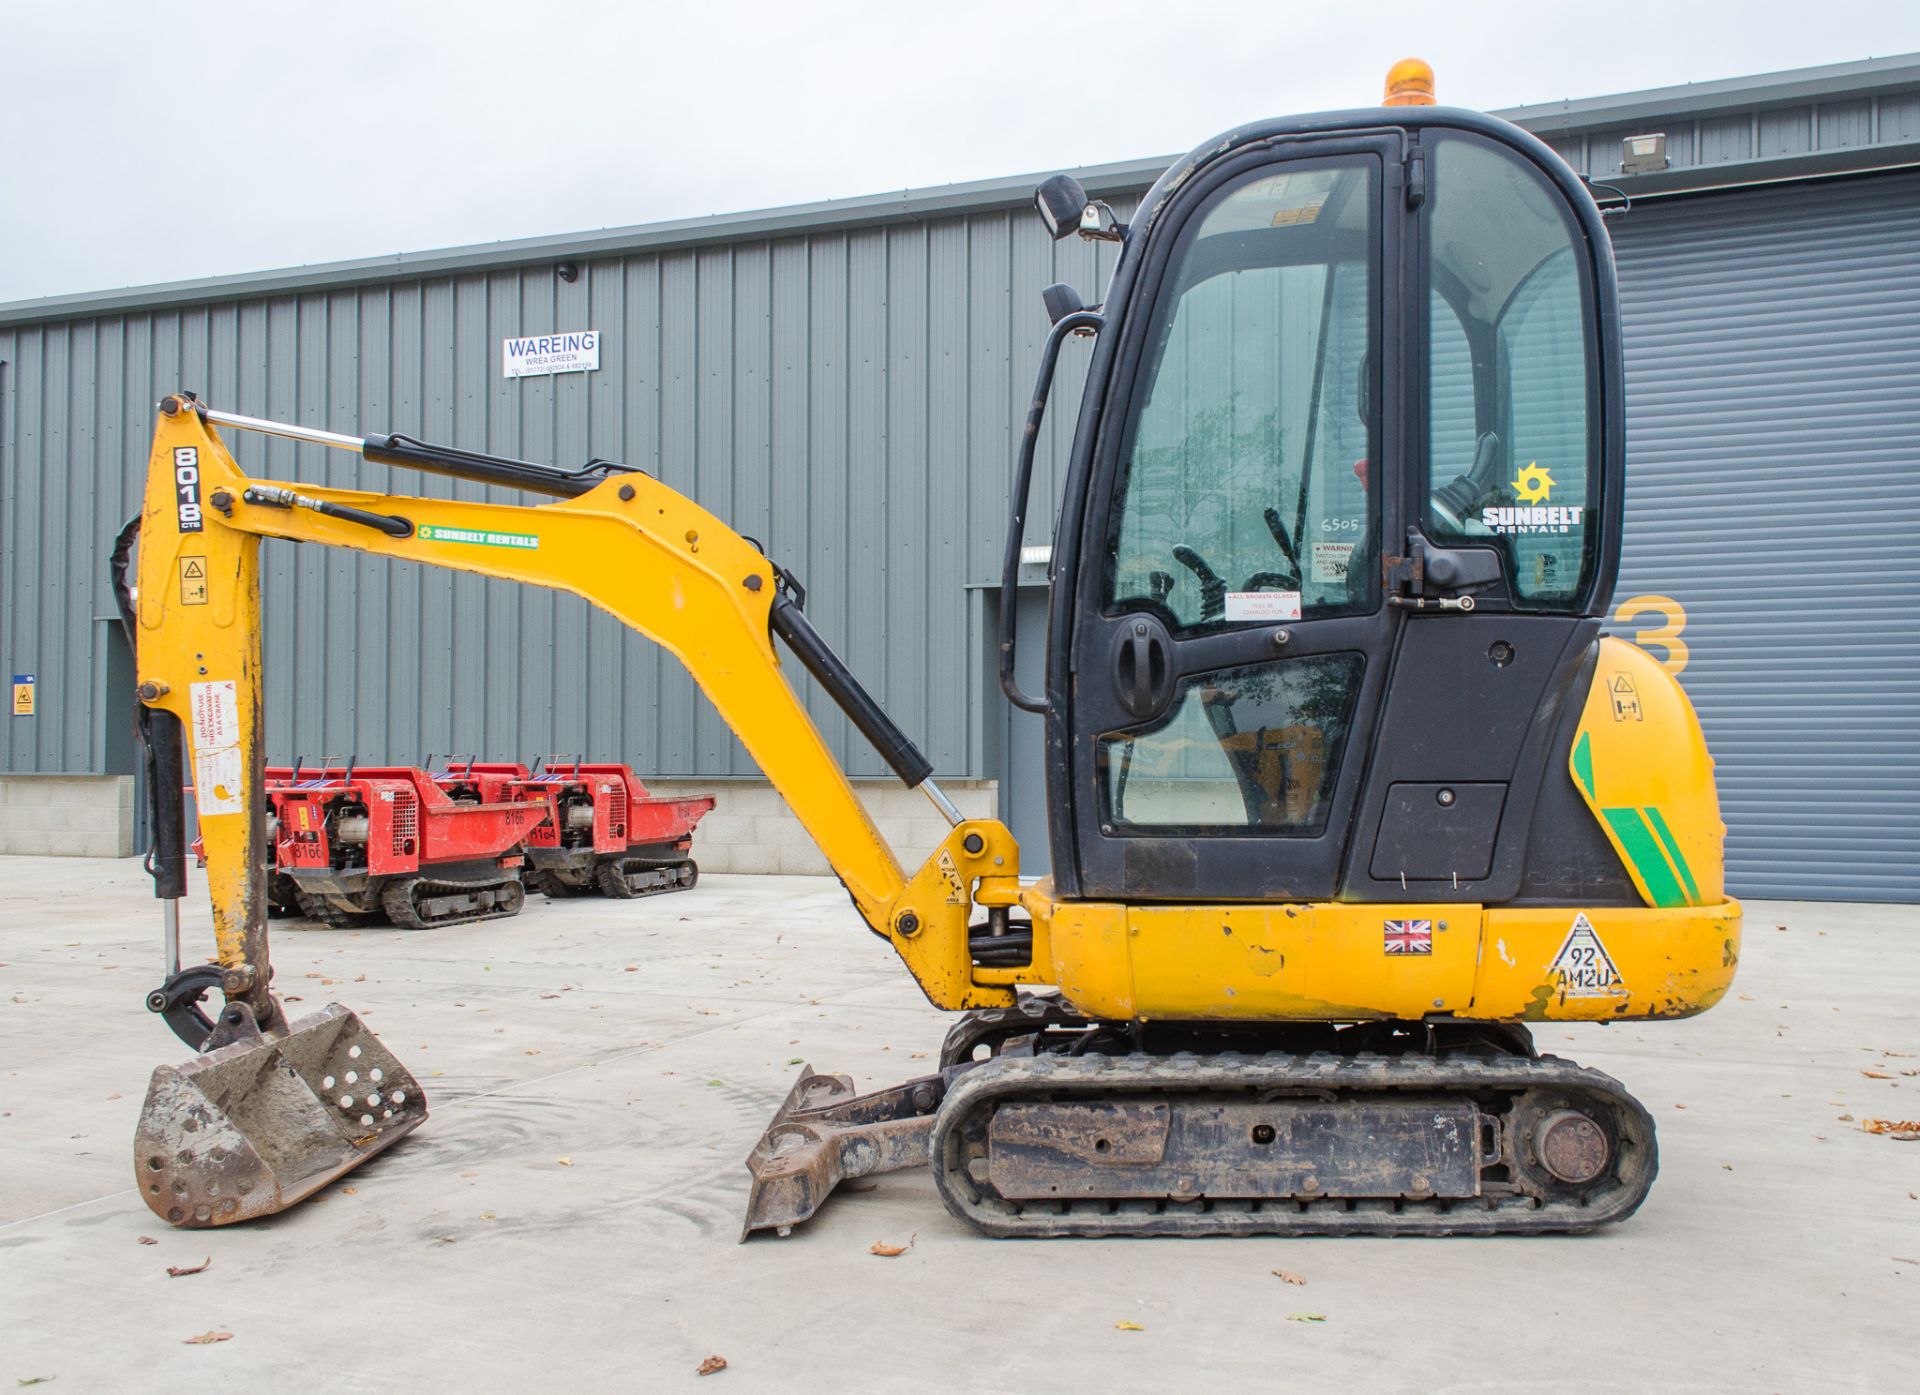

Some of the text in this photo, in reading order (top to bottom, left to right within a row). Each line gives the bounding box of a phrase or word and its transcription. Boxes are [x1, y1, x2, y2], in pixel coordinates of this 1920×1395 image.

[509, 334, 594, 357] WAREING
[526, 354, 577, 365] WREA GREEN
[175, 447, 201, 522] 8018
[1321, 518, 1359, 531] 6505
[1482, 506, 1583, 526] SUNBELT
[434, 528, 539, 547] SUNBELT RENTALS
[1496, 525, 1569, 533] RENTALS
[1614, 594, 1689, 677] 3
[206, 684, 214, 727] EXCAVATOR
[200, 726, 207, 738] DO
[506, 810, 525, 825] 8166
[294, 843, 321, 858] 8166
[1571, 947, 1595, 967] 92
[1557, 968, 1610, 987] AM2U
